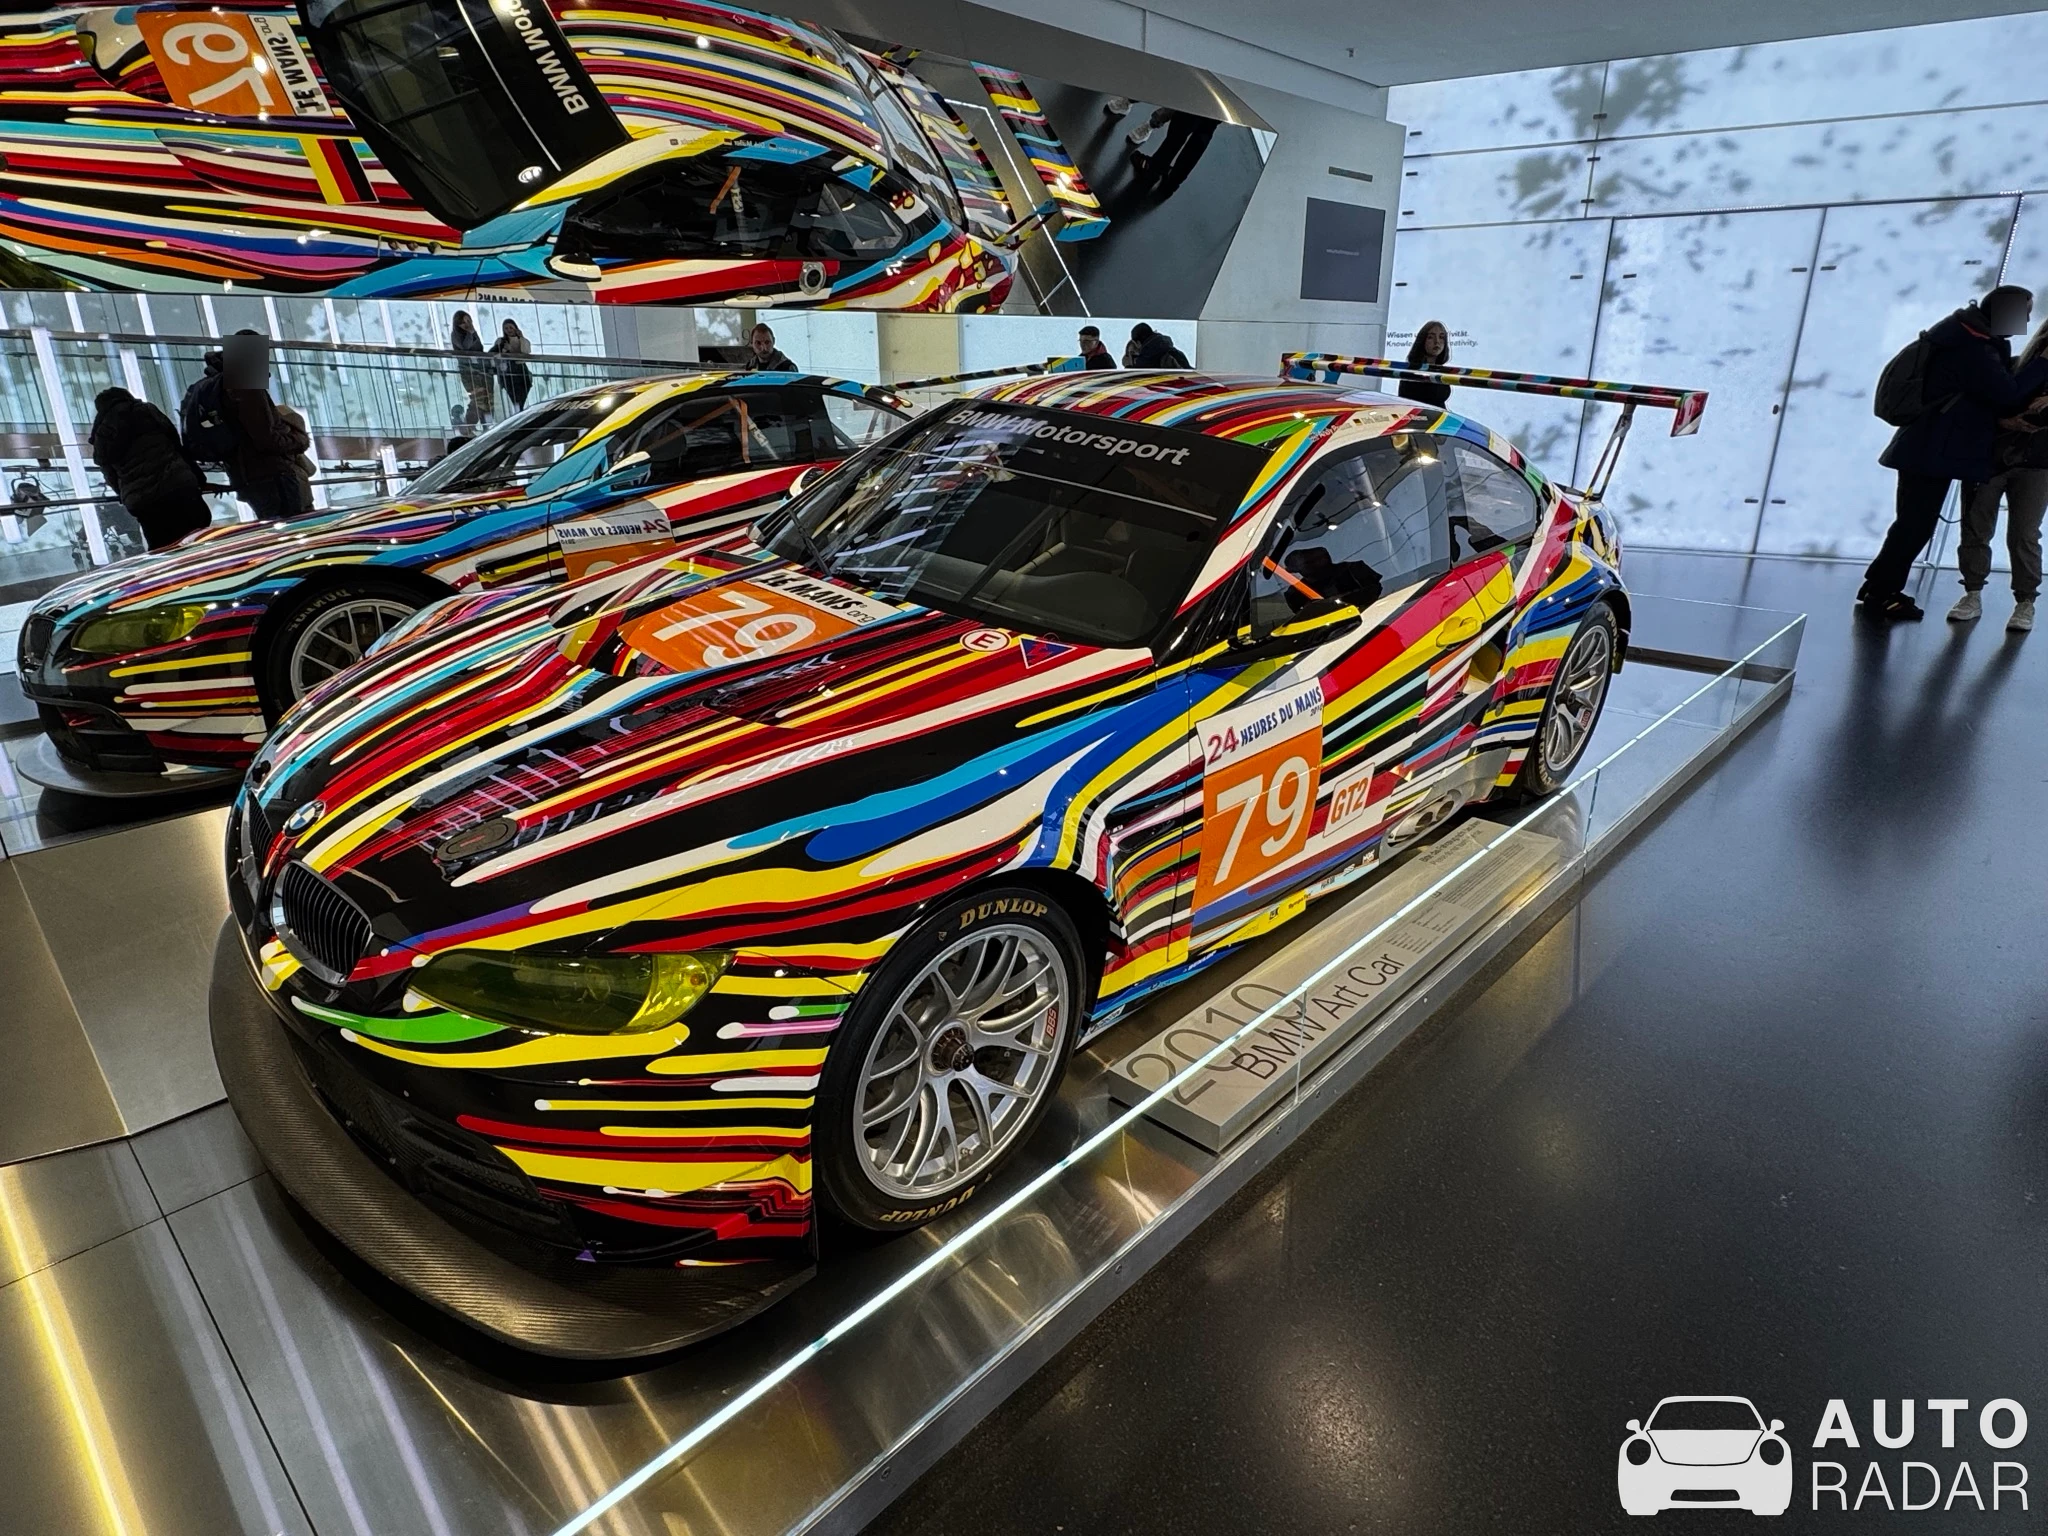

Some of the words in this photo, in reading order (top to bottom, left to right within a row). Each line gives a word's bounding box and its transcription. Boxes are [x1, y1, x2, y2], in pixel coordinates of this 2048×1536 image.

[946, 410, 1020, 431] BMW
[1009, 418, 1190, 466] Motorsport
[652, 590, 817, 668] 79
[1207, 726, 1240, 767] 24
[1240, 712, 1278, 746] HEURES
[1279, 705, 1293, 724] DU
[1295, 686, 1322, 716] MANS
[1213, 756, 1310, 886] 79
[1331, 777, 1369, 825] GT2
[959, 898, 1048, 931] DUNLOP
[1046, 1007, 1057, 1038] BBS
[1126, 983, 1307, 1105] 2010
[1231, 1010, 1327, 1080] BMW
[1311, 984, 1370, 1020] Art
[1347, 953, 1406, 987] Car
[879, 1185, 976, 1223] DUNLOP
